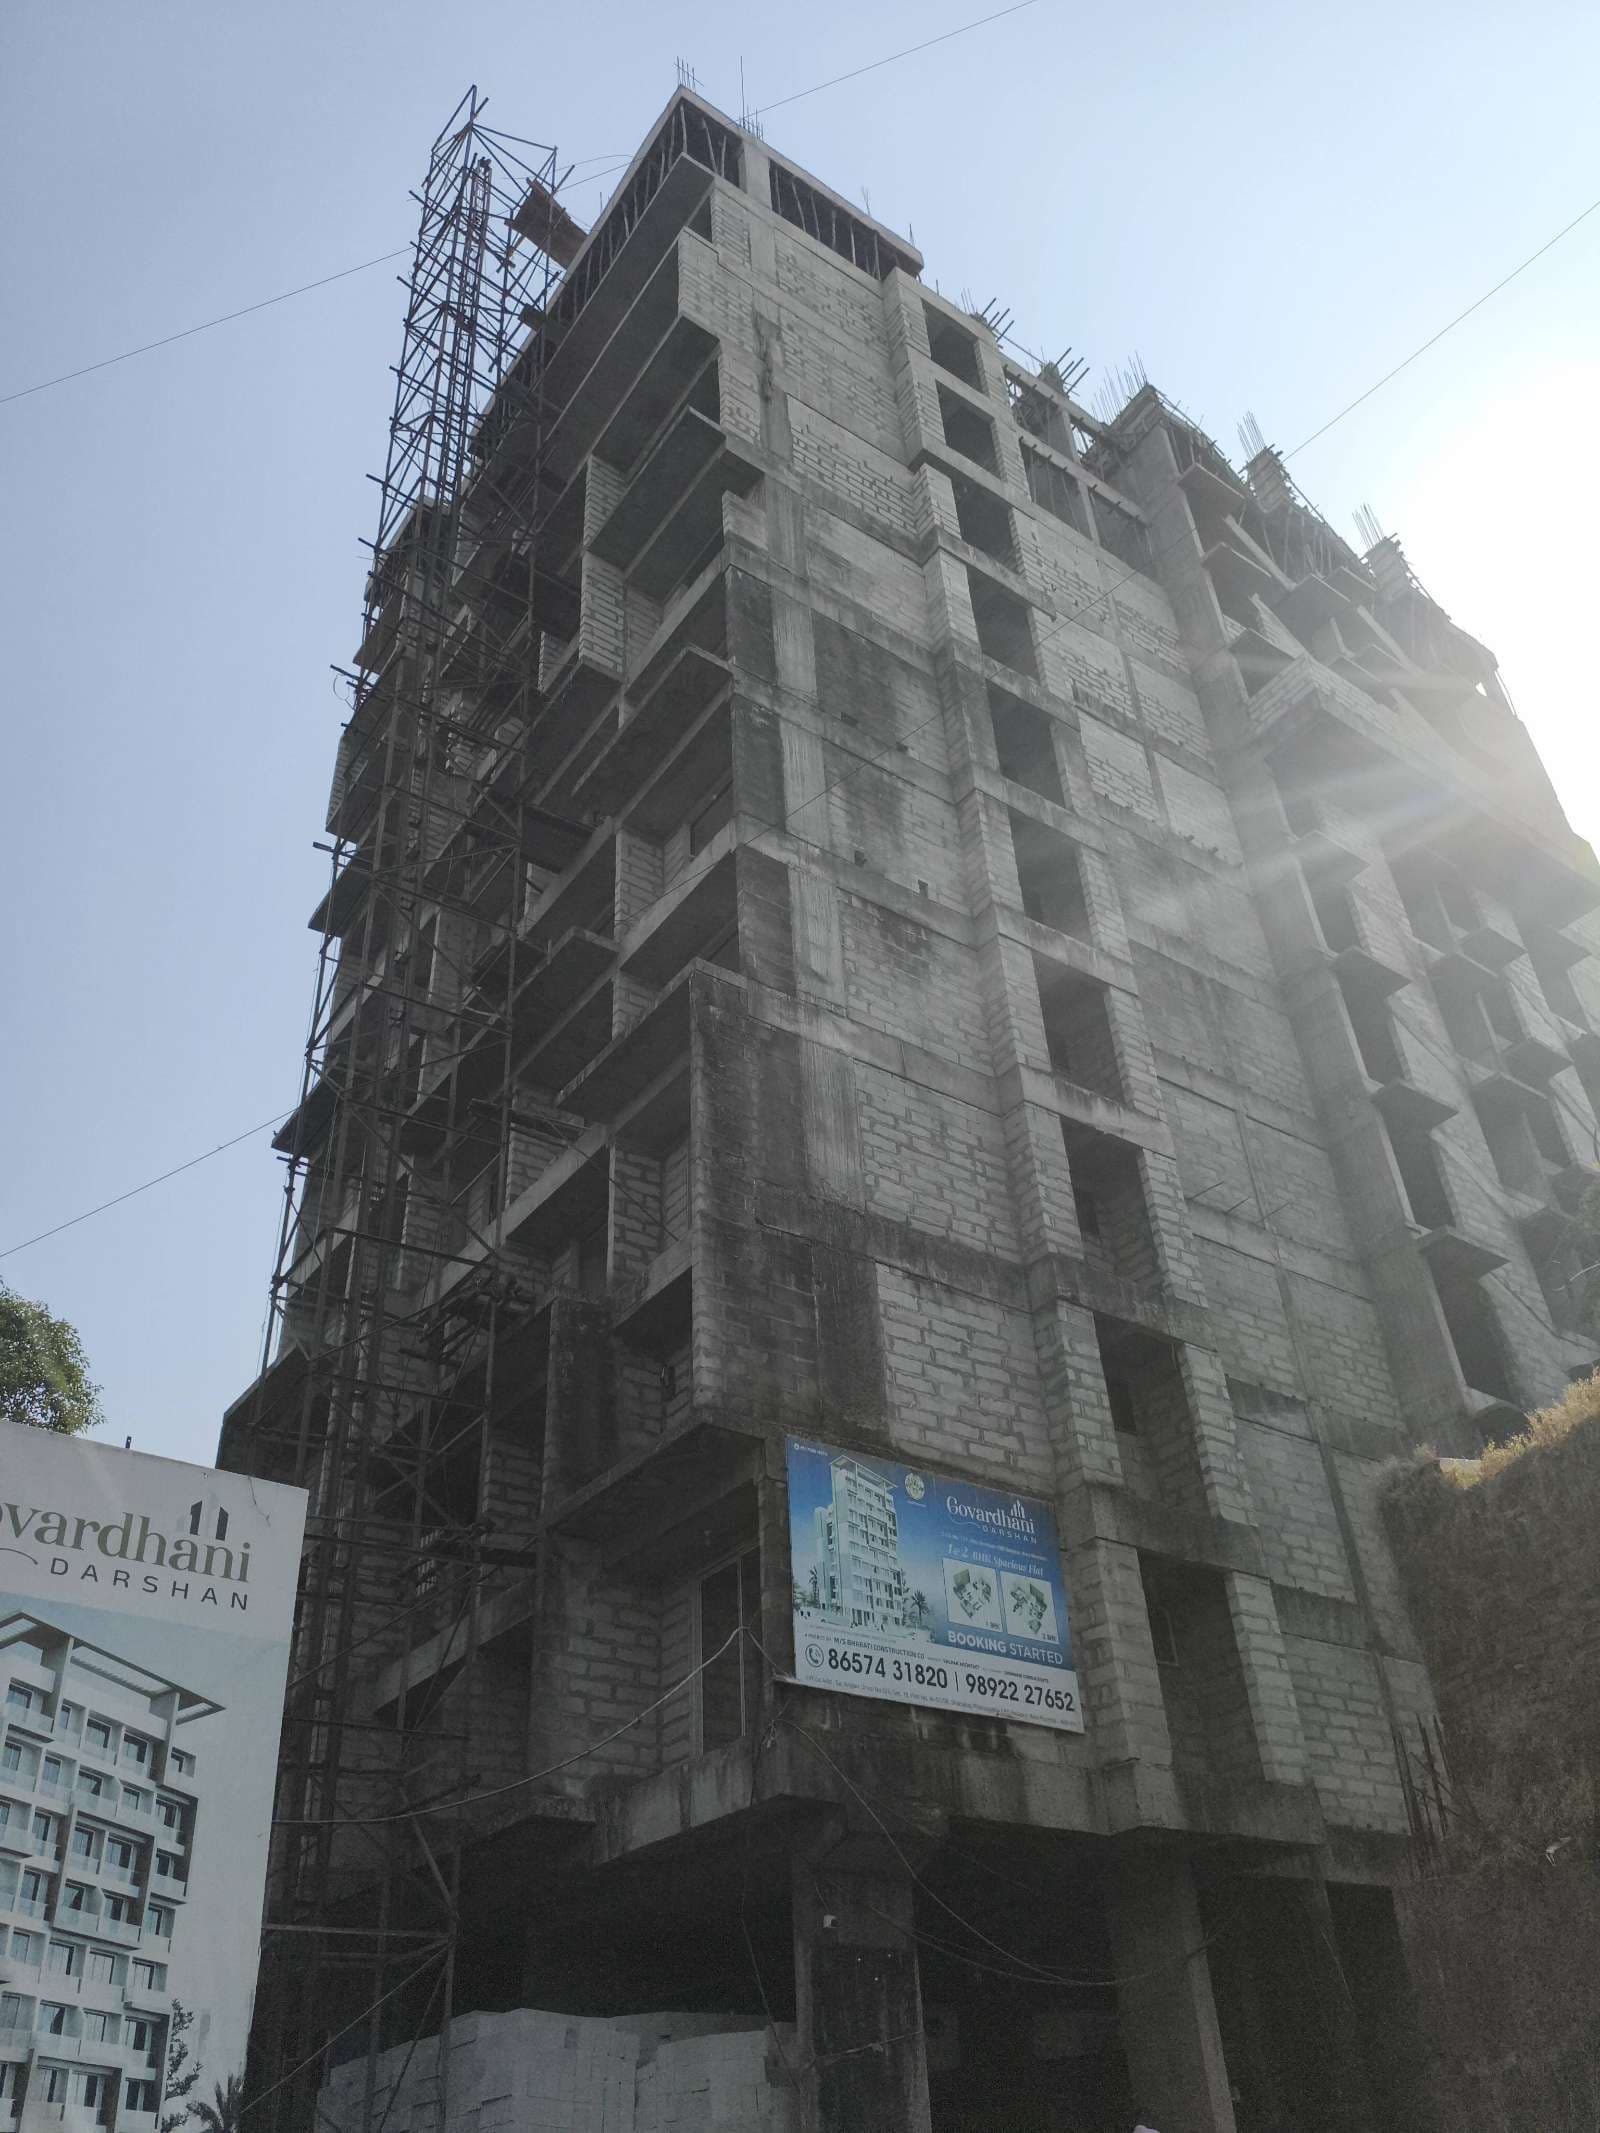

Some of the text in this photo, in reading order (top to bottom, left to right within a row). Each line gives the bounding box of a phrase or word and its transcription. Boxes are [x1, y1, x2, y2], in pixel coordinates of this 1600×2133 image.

[946, 1495, 1035, 1534] Govardhani
[0, 1502, 250, 1583] vardhani
[961, 1546, 969, 1558] 2
[982, 1525, 1037, 1544] DARSHAN
[50, 1557, 249, 1611] DARSHAN
[947, 1630, 1064, 1665] BOOKING STARTED
[828, 1648, 886, 1678] 86574
[893, 1659, 948, 1689] 31820
[965, 1673, 1019, 1702] 98922
[1023, 1684, 1076, 1712] 27652
